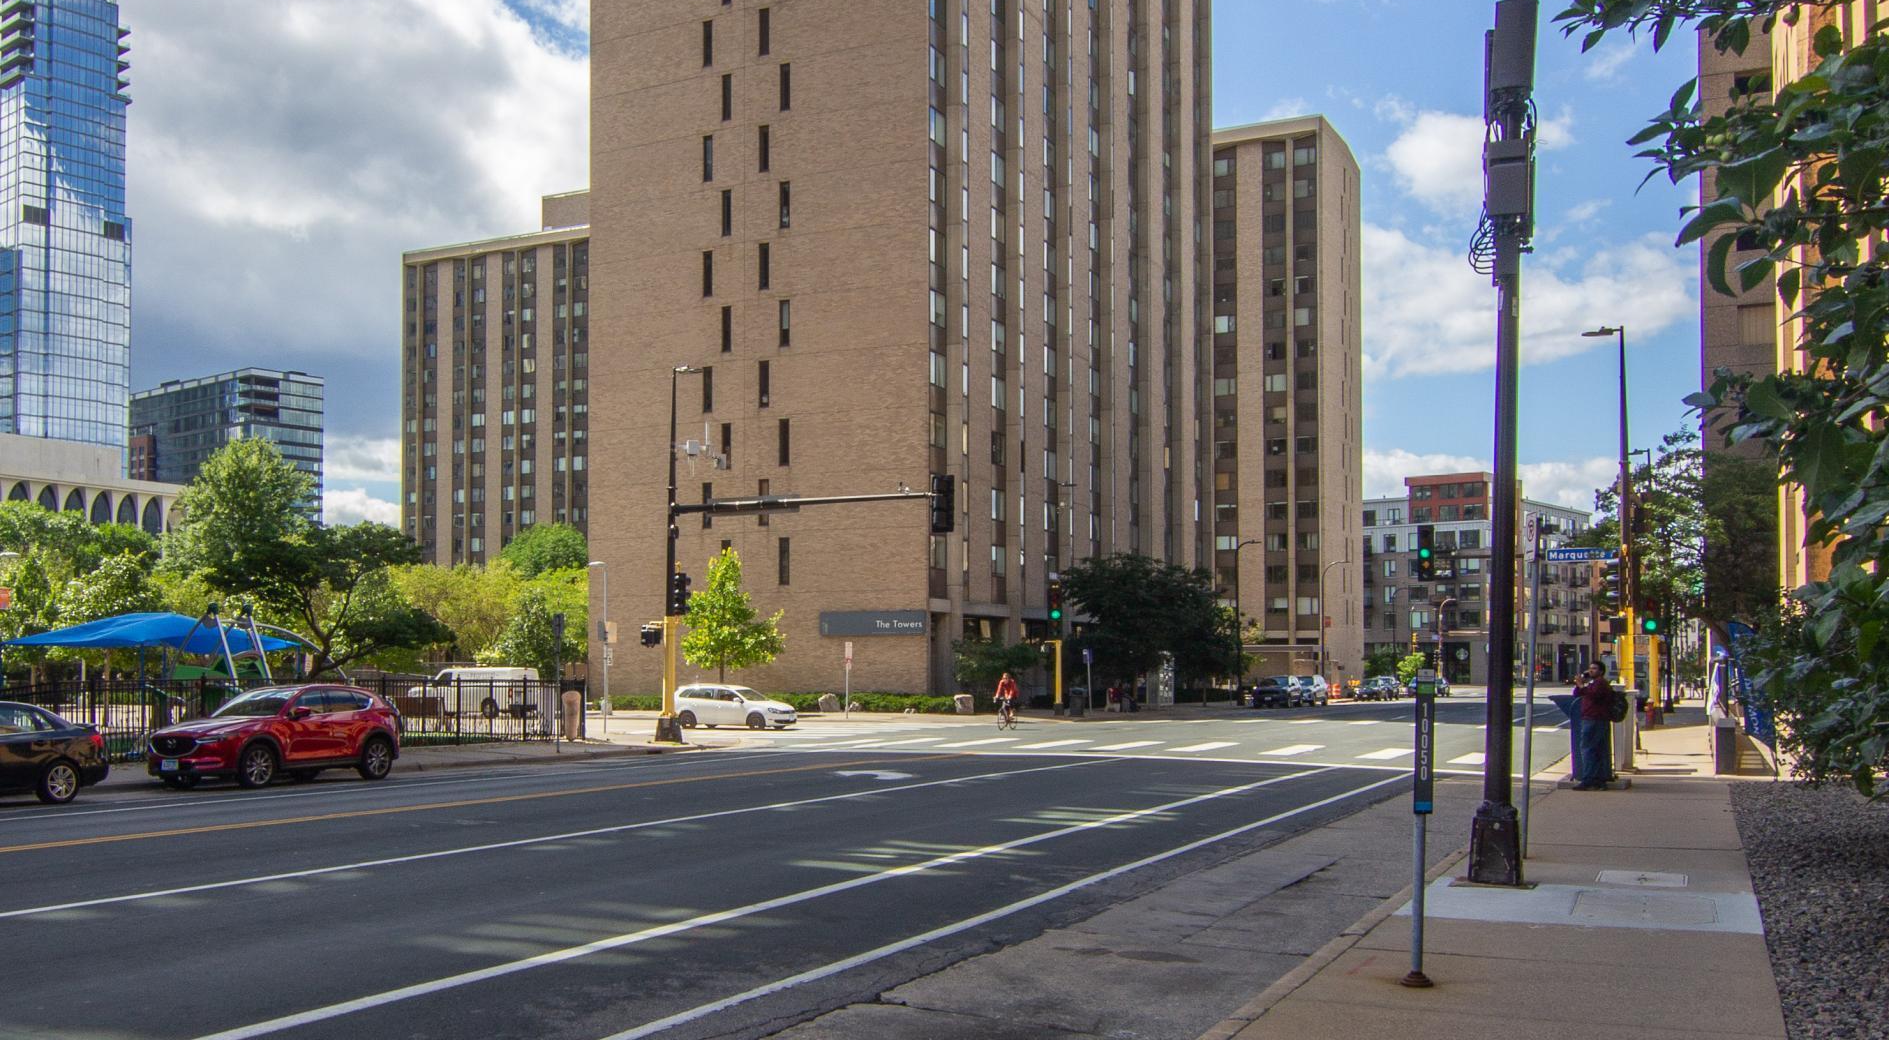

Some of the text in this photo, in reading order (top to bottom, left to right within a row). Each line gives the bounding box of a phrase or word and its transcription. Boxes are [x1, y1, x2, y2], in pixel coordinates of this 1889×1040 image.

[876, 620, 922, 629] The Towers
[1420, 702, 1429, 781] 10050
